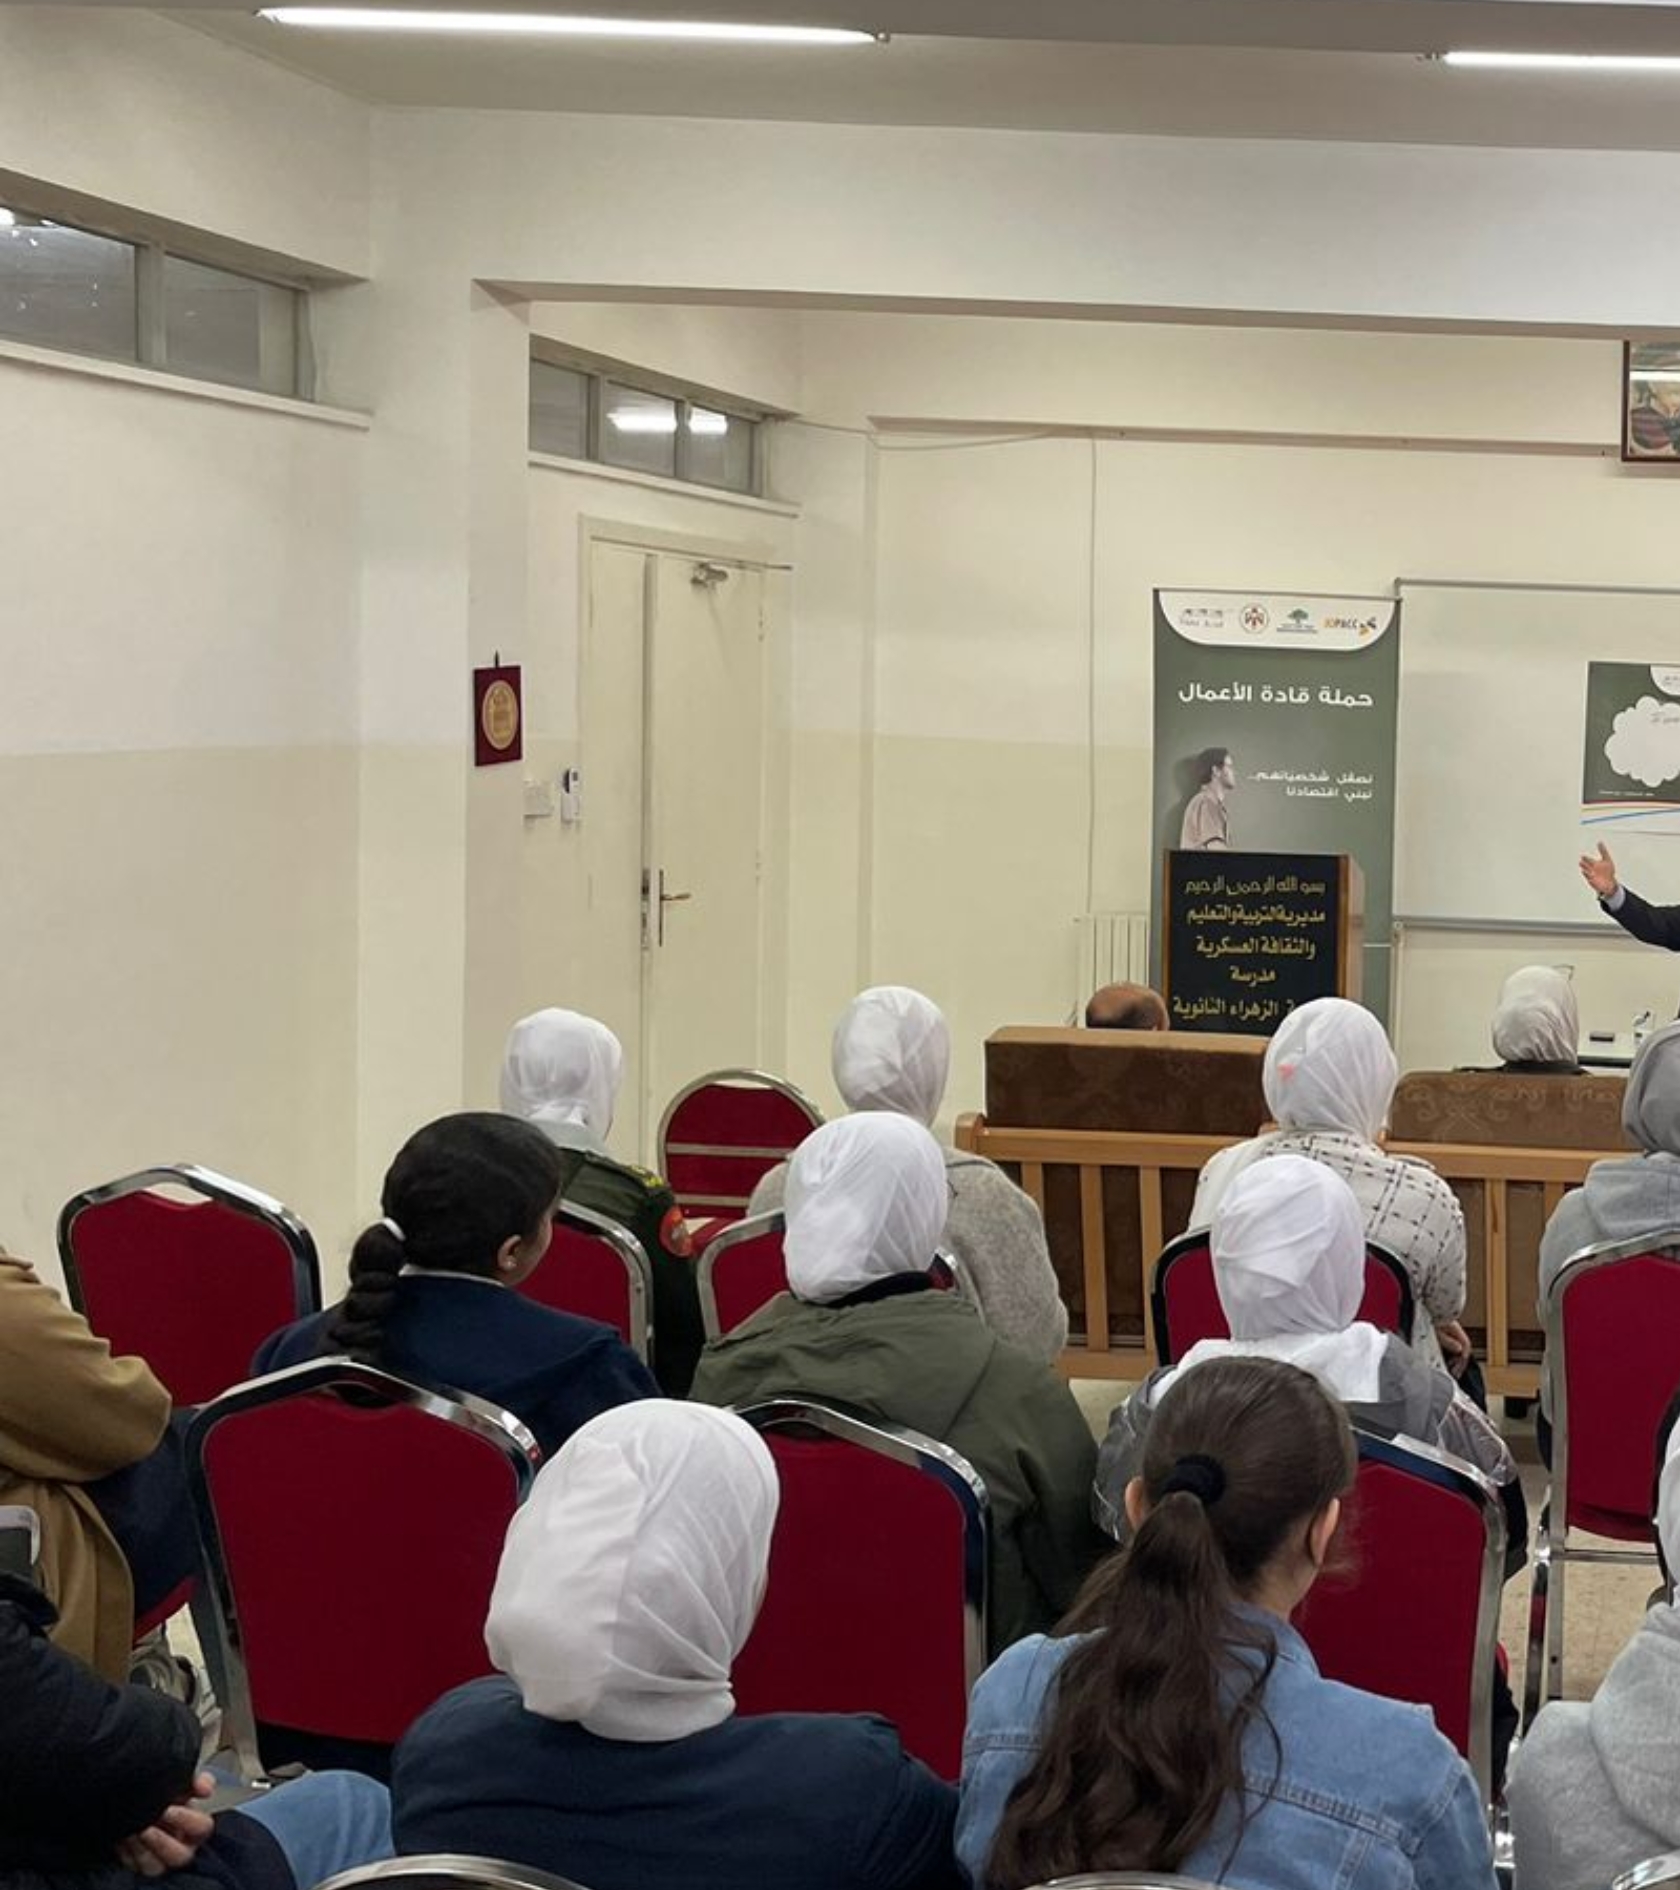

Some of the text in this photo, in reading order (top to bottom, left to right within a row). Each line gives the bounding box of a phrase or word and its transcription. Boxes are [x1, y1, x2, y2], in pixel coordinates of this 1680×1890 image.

[1178, 681, 1374, 706] حملة قادة الأعمال
[1276, 874, 1298, 893] الله
[1195, 935, 1316, 961] والثقافة العسكرية
[1229, 964, 1277, 988] مدرسة
[1172, 996, 1226, 1020] الثانوية
[1229, 999, 1279, 1022] الزهراء
